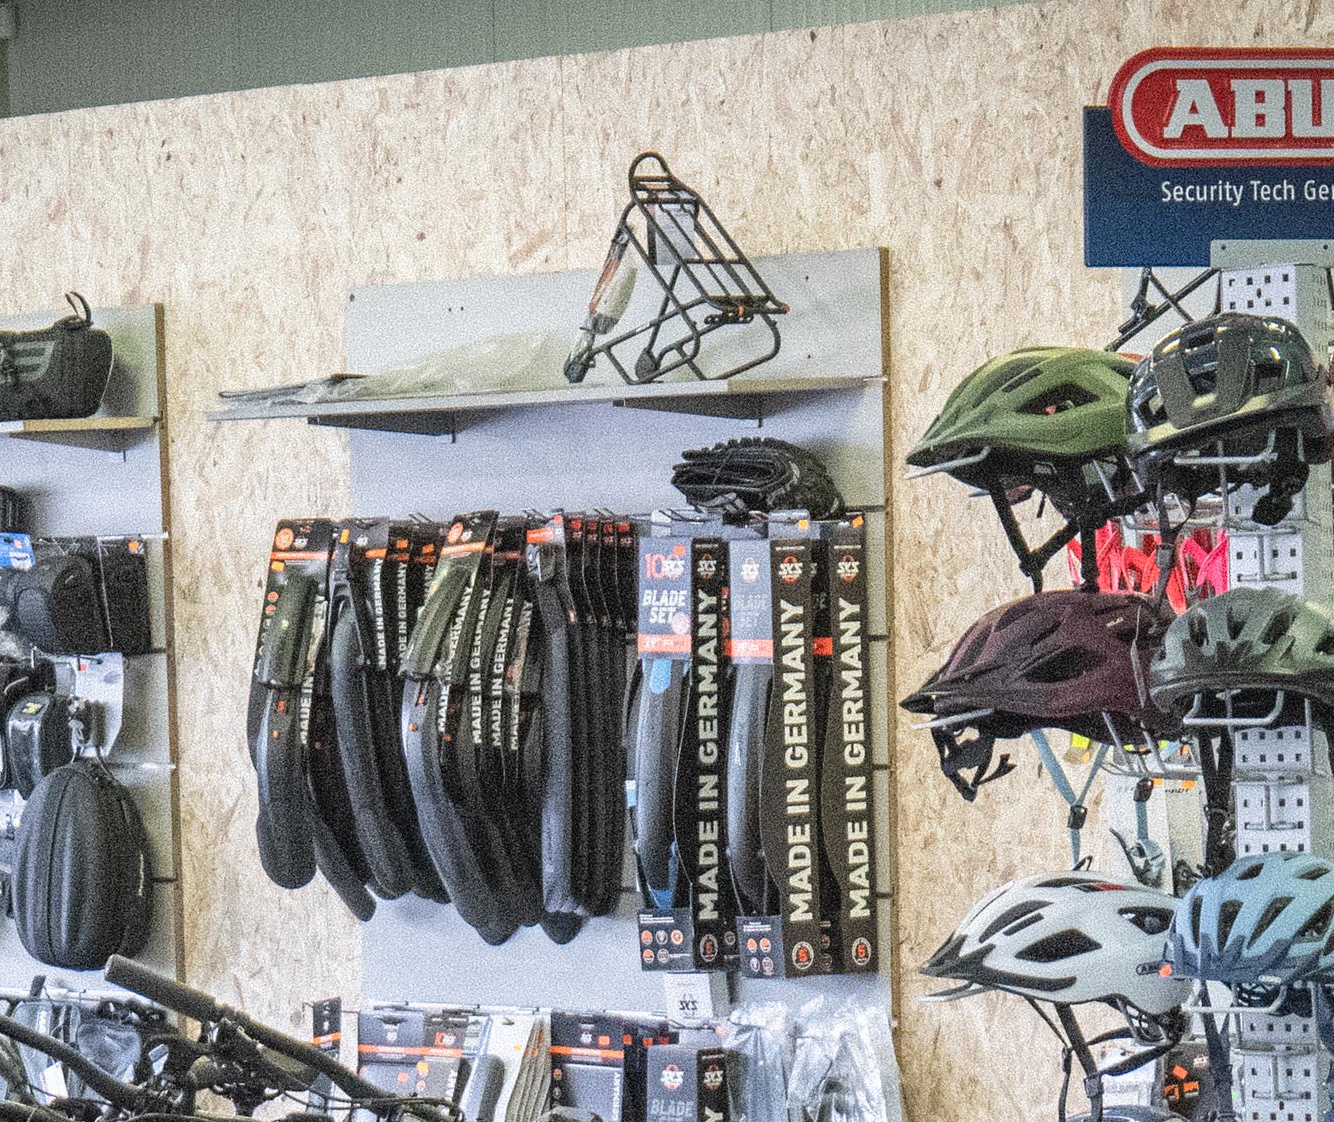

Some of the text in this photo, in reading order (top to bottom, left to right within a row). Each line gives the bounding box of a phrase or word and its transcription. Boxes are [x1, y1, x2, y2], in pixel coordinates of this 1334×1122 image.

[1161, 179, 1246, 206] Security
[1250, 179, 1296, 202] Tech
[778, 561, 804, 576] SKS
[837, 560, 861, 575] SKS
[396, 562, 408, 619] GERMANY
[643, 590, 687, 607] BLADE
[373, 558, 387, 667] MADE IN GERMANY
[649, 607, 676, 624] SET
[398, 636, 408, 663] ADE
[470, 674, 482, 690] IN
[492, 678, 502, 695] IN
[471, 694, 483, 743] MADE
[491, 699, 502, 747] MADE
[697, 588, 718, 921] MADE IN GERMANY
[780, 599, 813, 922] MADE IN GERMANY
[838, 597, 871, 918] MADE IN GERMANY
[650, 1099, 693, 1118] BLADE
